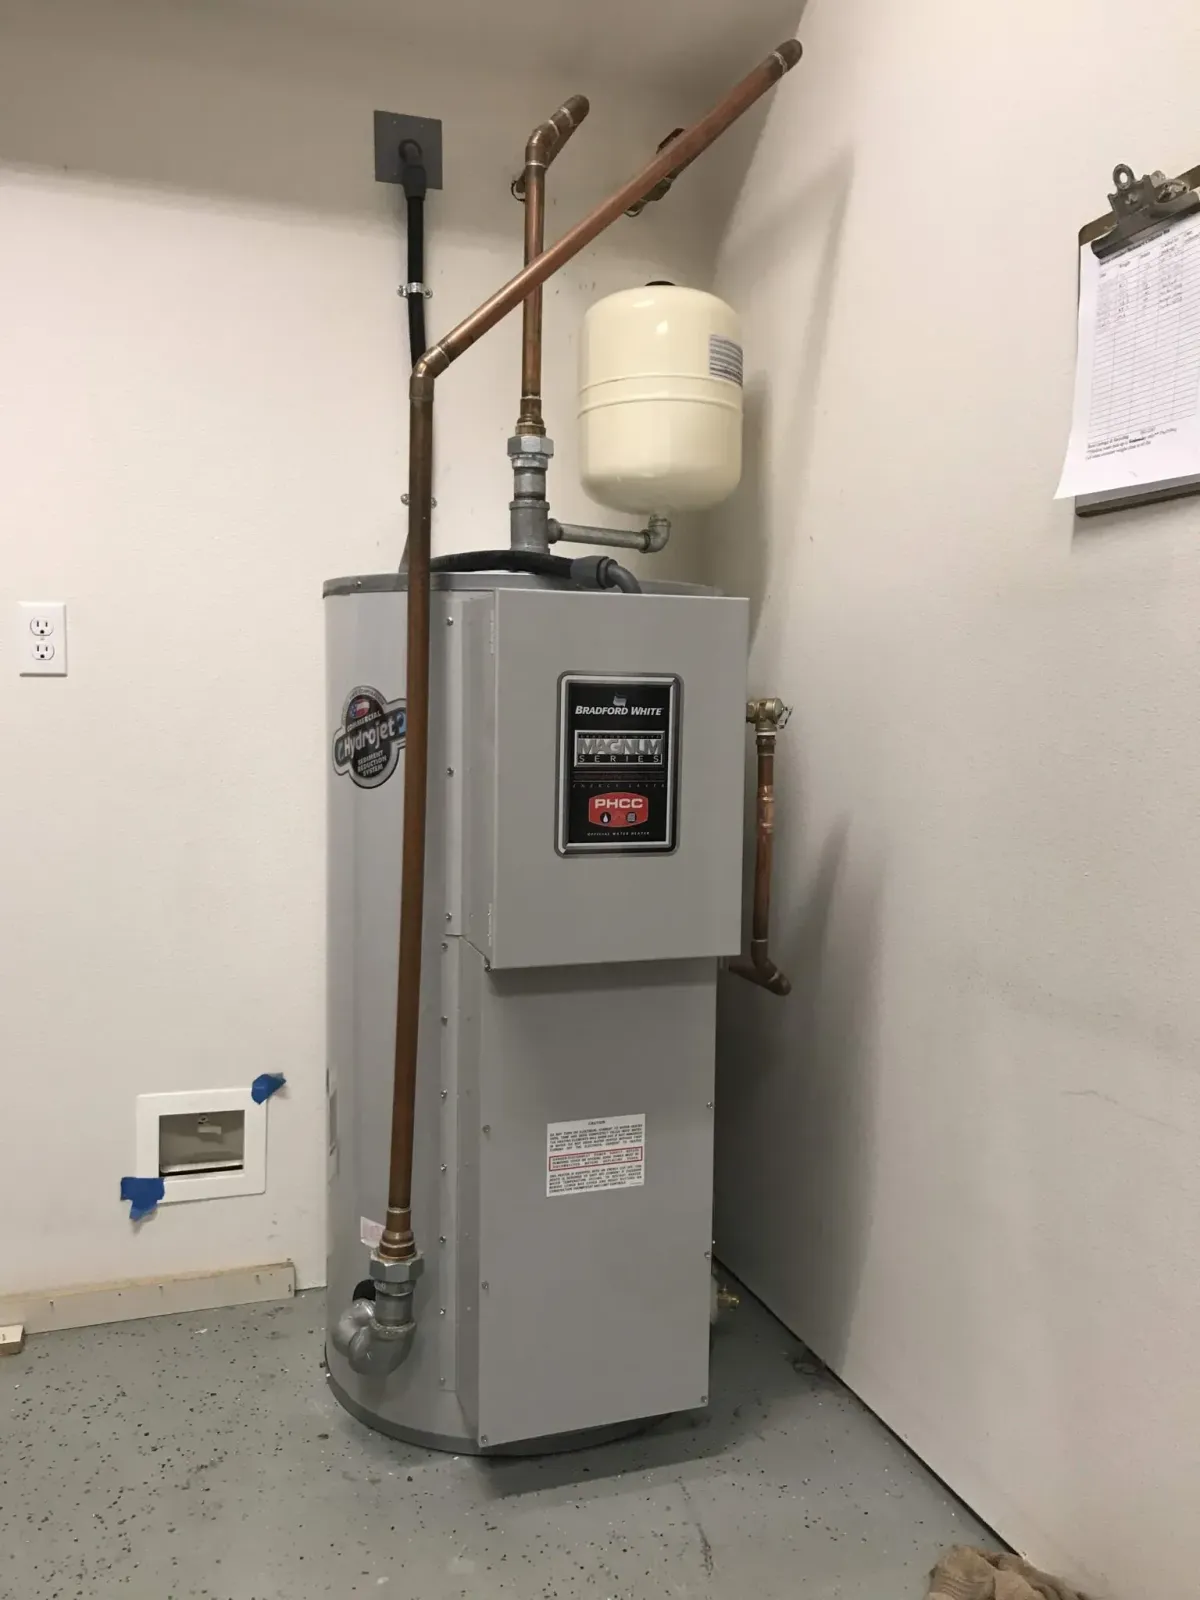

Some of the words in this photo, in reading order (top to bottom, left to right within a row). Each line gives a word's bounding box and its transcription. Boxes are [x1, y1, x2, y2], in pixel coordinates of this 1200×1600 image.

[575, 705, 629, 715] BRADFORD
[631, 706, 662, 715] WHITE
[347, 711, 381, 732] COMMERCIAL
[344, 716, 395, 758] Hydrojet
[579, 739, 661, 754] MAGNUM
[579, 755, 659, 763] SERIES
[594, 798, 643, 809] PHCC
